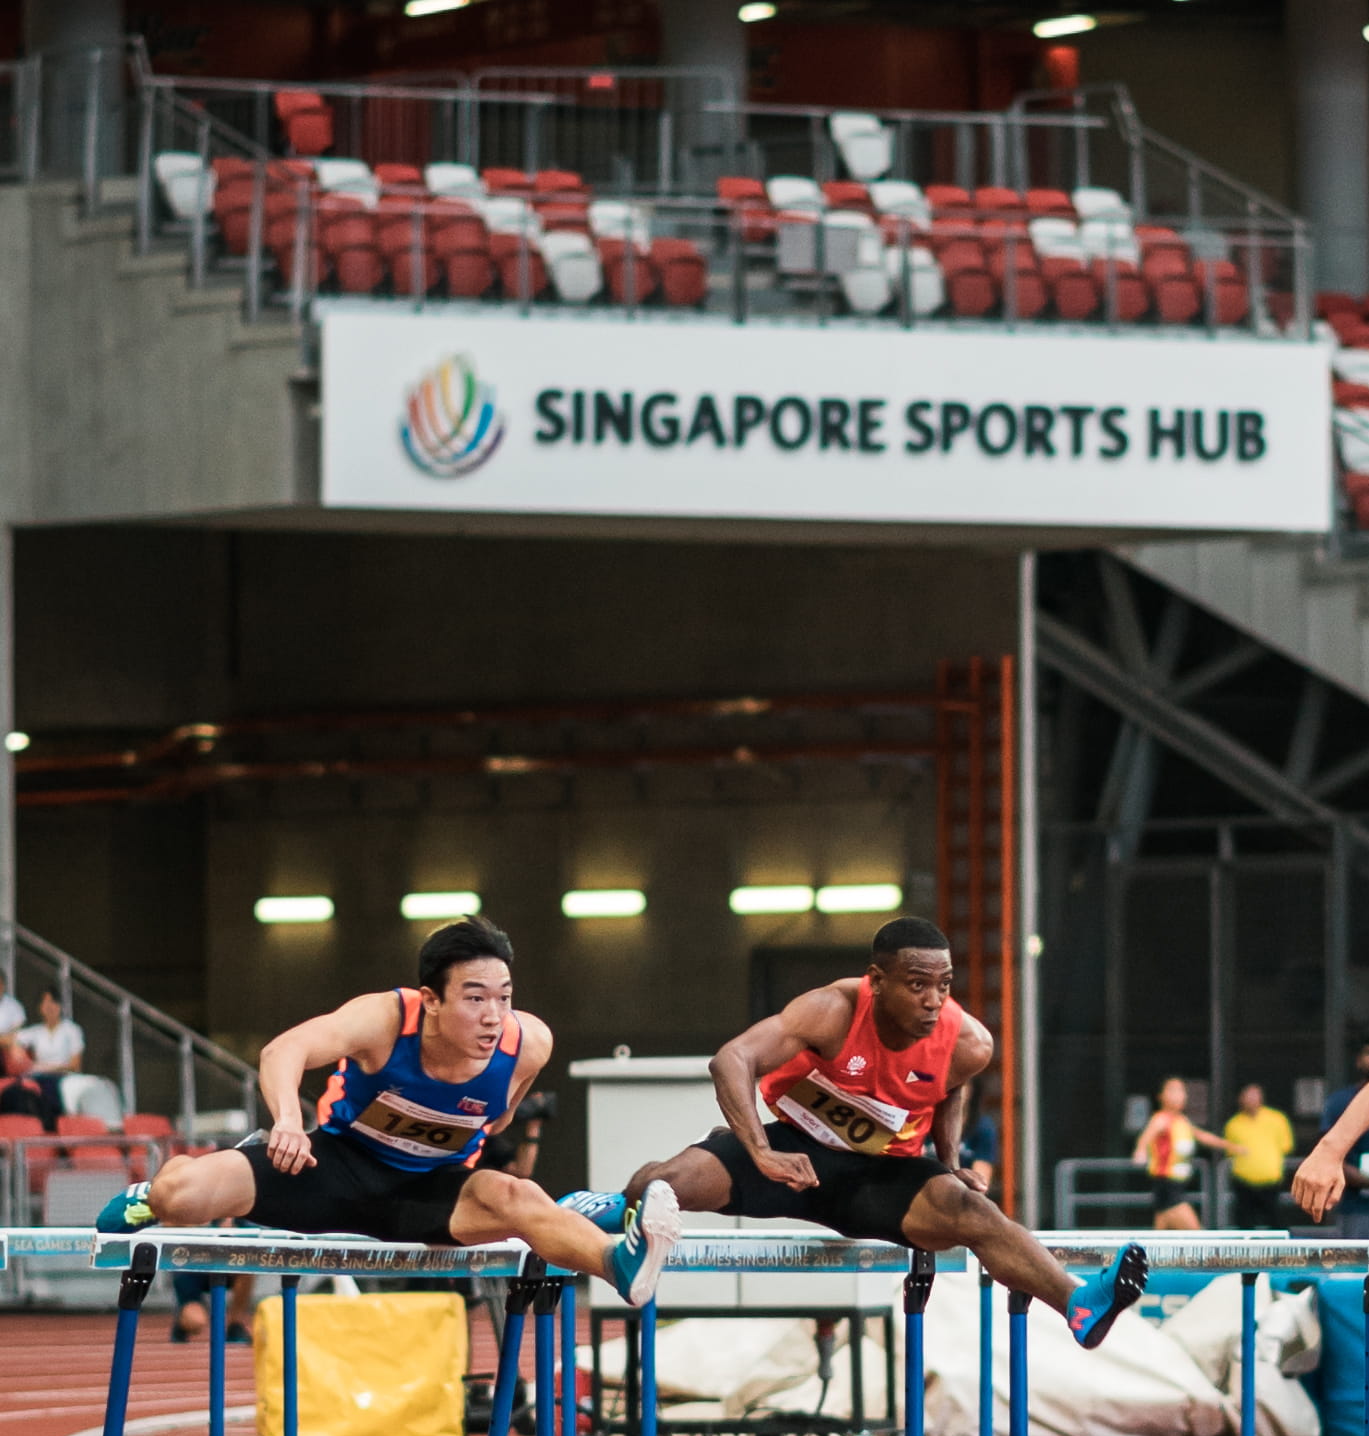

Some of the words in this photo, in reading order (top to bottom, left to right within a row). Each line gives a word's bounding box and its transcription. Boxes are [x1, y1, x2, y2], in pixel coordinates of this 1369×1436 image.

[535, 388, 888, 453] SINGAPORE
[905, 400, 1129, 459] SPORTS
[1147, 407, 1267, 463] HUB
[384, 1112, 456, 1144] 156
[810, 1090, 876, 1144] 180
[260, 1254, 285, 1267] SEA
[288, 1255, 337, 1269] GAMES
